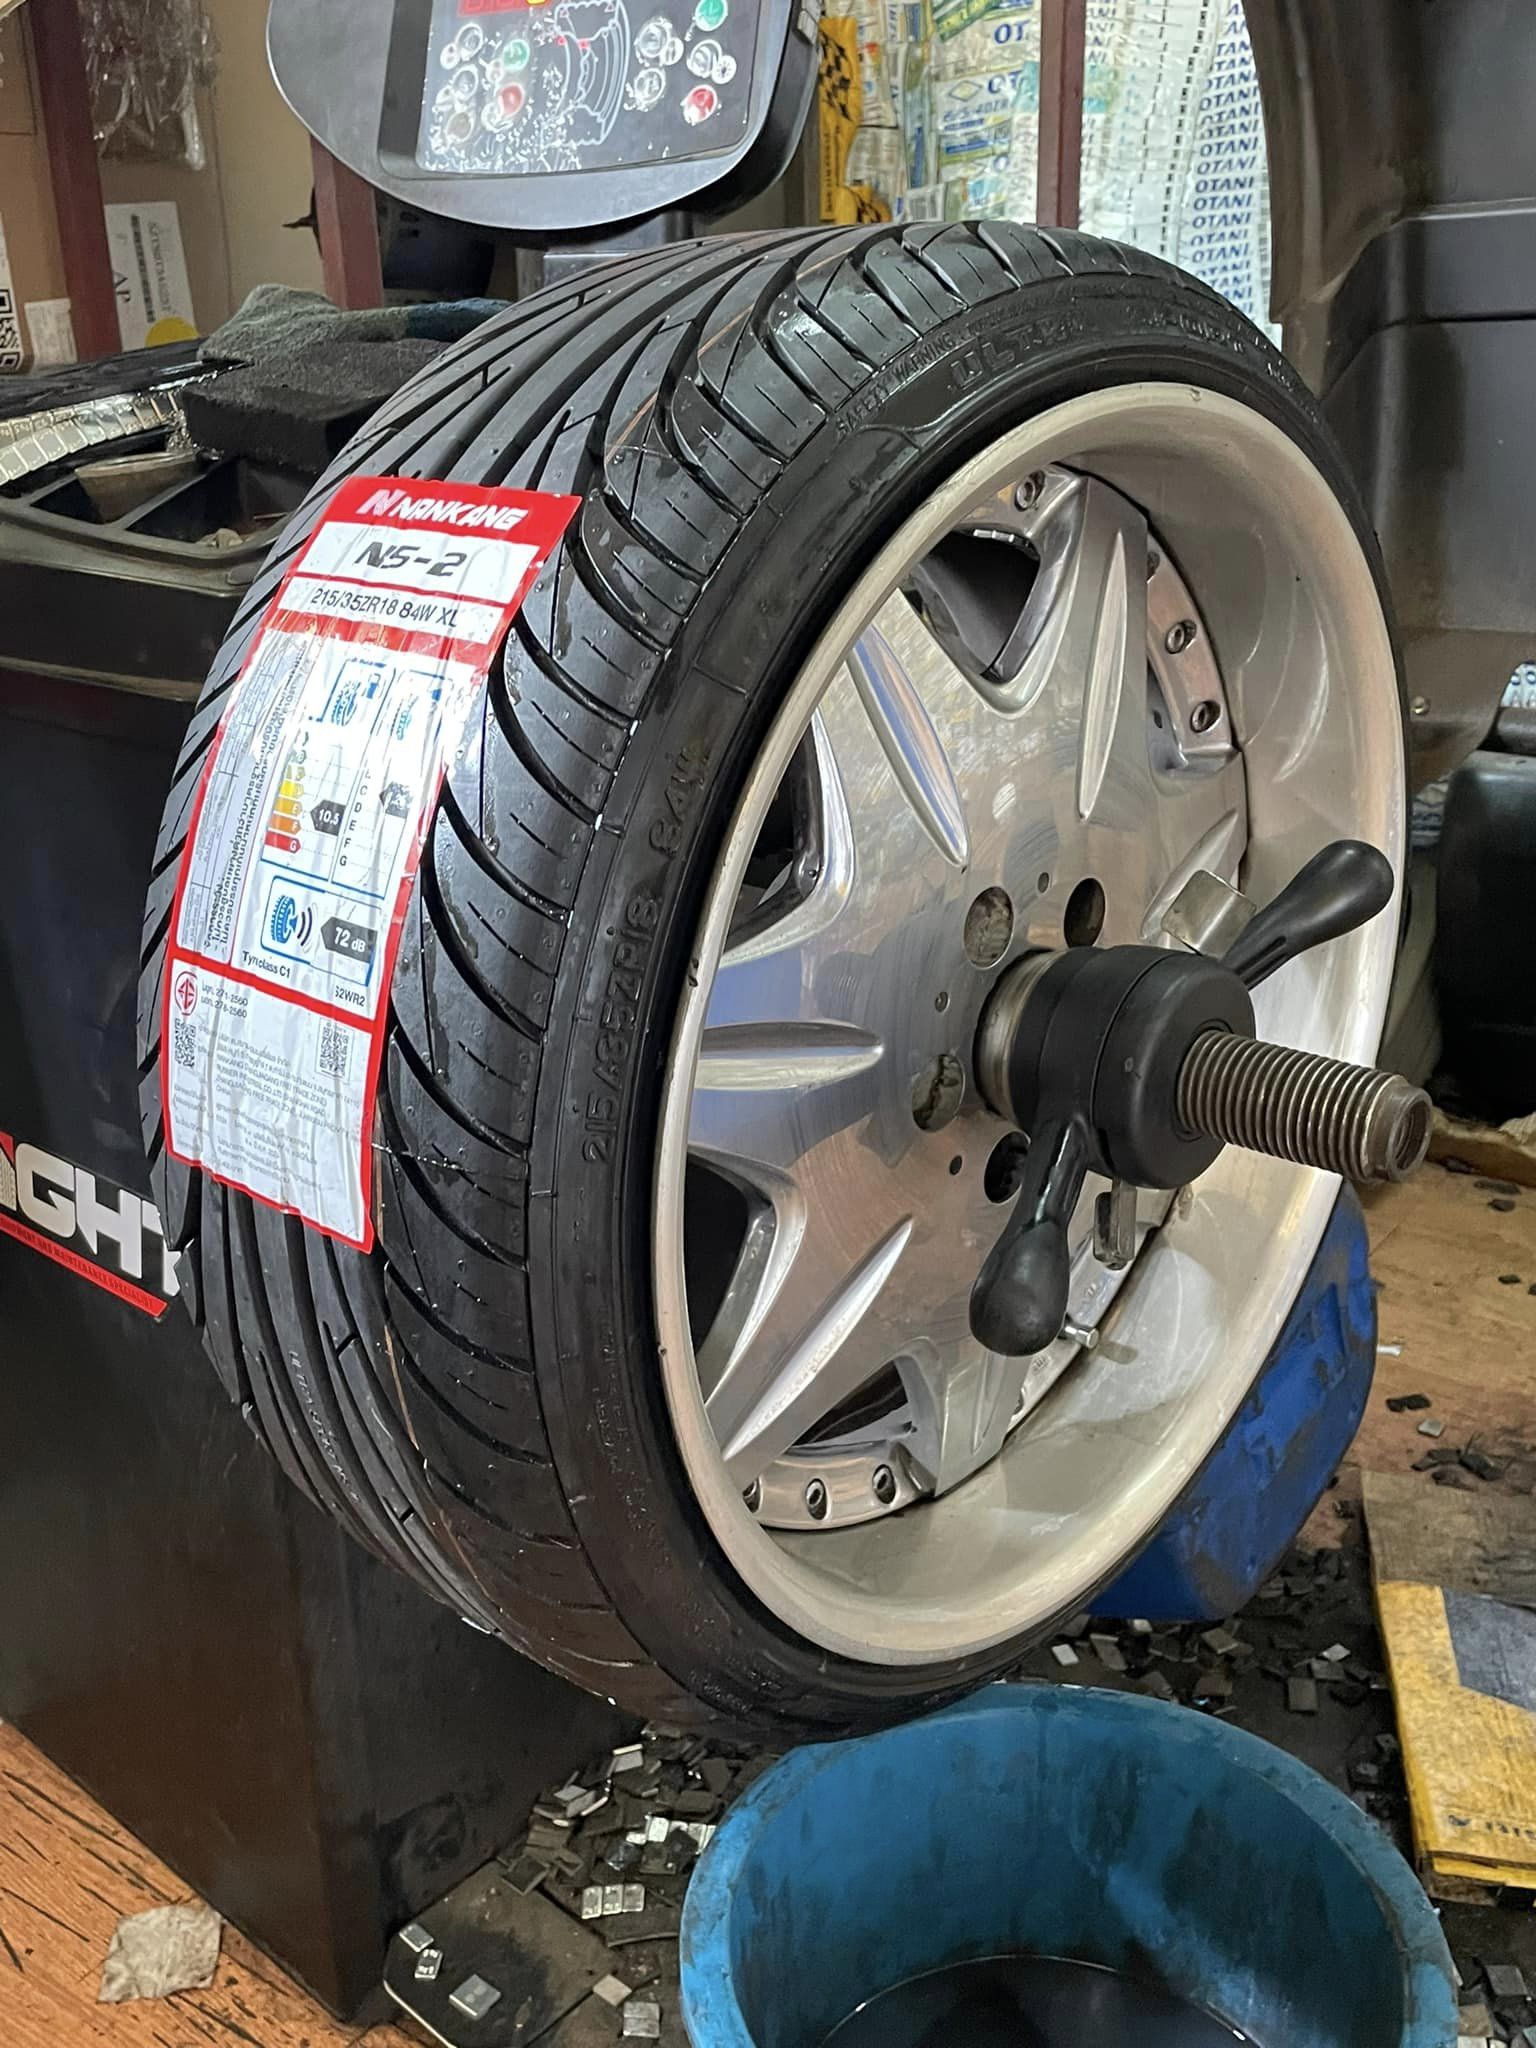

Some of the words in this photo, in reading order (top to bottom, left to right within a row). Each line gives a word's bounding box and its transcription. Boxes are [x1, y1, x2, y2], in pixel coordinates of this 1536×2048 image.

[1199, 86, 1258, 111] OTANI
[1200, 136, 1258, 157] OTANI
[1197, 156, 1256, 175] OTANI
[1195, 176, 1254, 193] OTANI
[1193, 194, 1252, 211] OTANI
[1192, 212, 1251, 229] OTANI
[1192, 243, 1249, 263] OTANI
[388, 497, 529, 531] NANKANG
[354, 541, 467, 577] NS-2
[311, 588, 398, 615] 215/35ZR18
[399, 601, 437, 622] 84W
[436, 607, 458, 628] XL
[339, 856, 347, 867] G
[334, 927, 350, 948] 72
[351, 938, 366, 953] dB
[280, 965, 291, 978] C1
